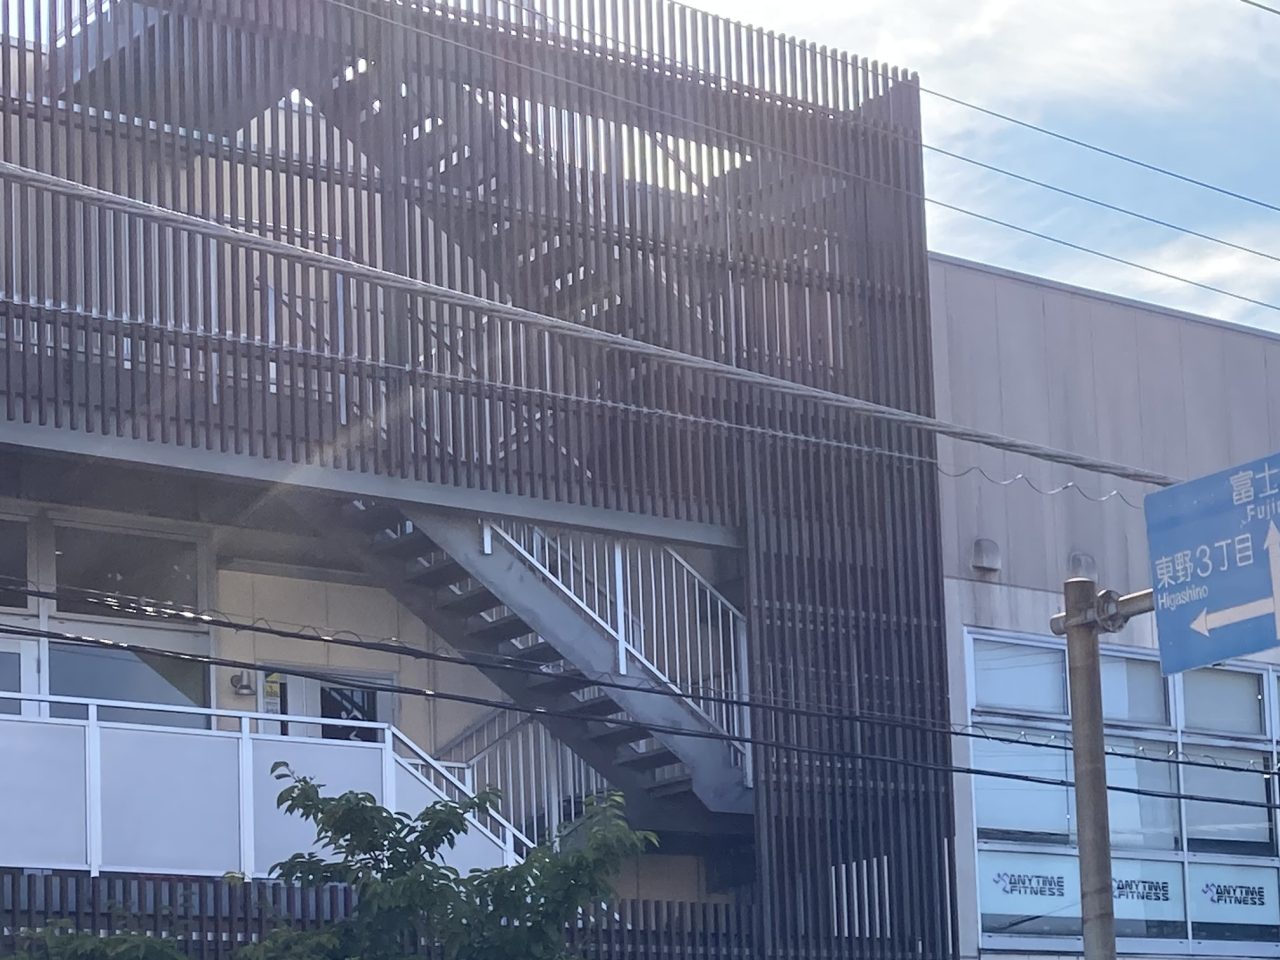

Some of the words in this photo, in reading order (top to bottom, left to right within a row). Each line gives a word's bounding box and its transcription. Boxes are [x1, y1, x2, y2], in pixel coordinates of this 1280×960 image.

[1154, 533, 1254, 589] 東野3丁目
[1157, 585, 1209, 610] Higashino
[1008, 875, 1065, 888] ANYTIME
[1116, 879, 1169, 892] ANYTIME
[1009, 886, 1065, 897] FITNESS
[1117, 891, 1170, 901] FITNESS
[1215, 885, 1265, 897] ANYTIME
[1216, 895, 1266, 906] FITNESS
